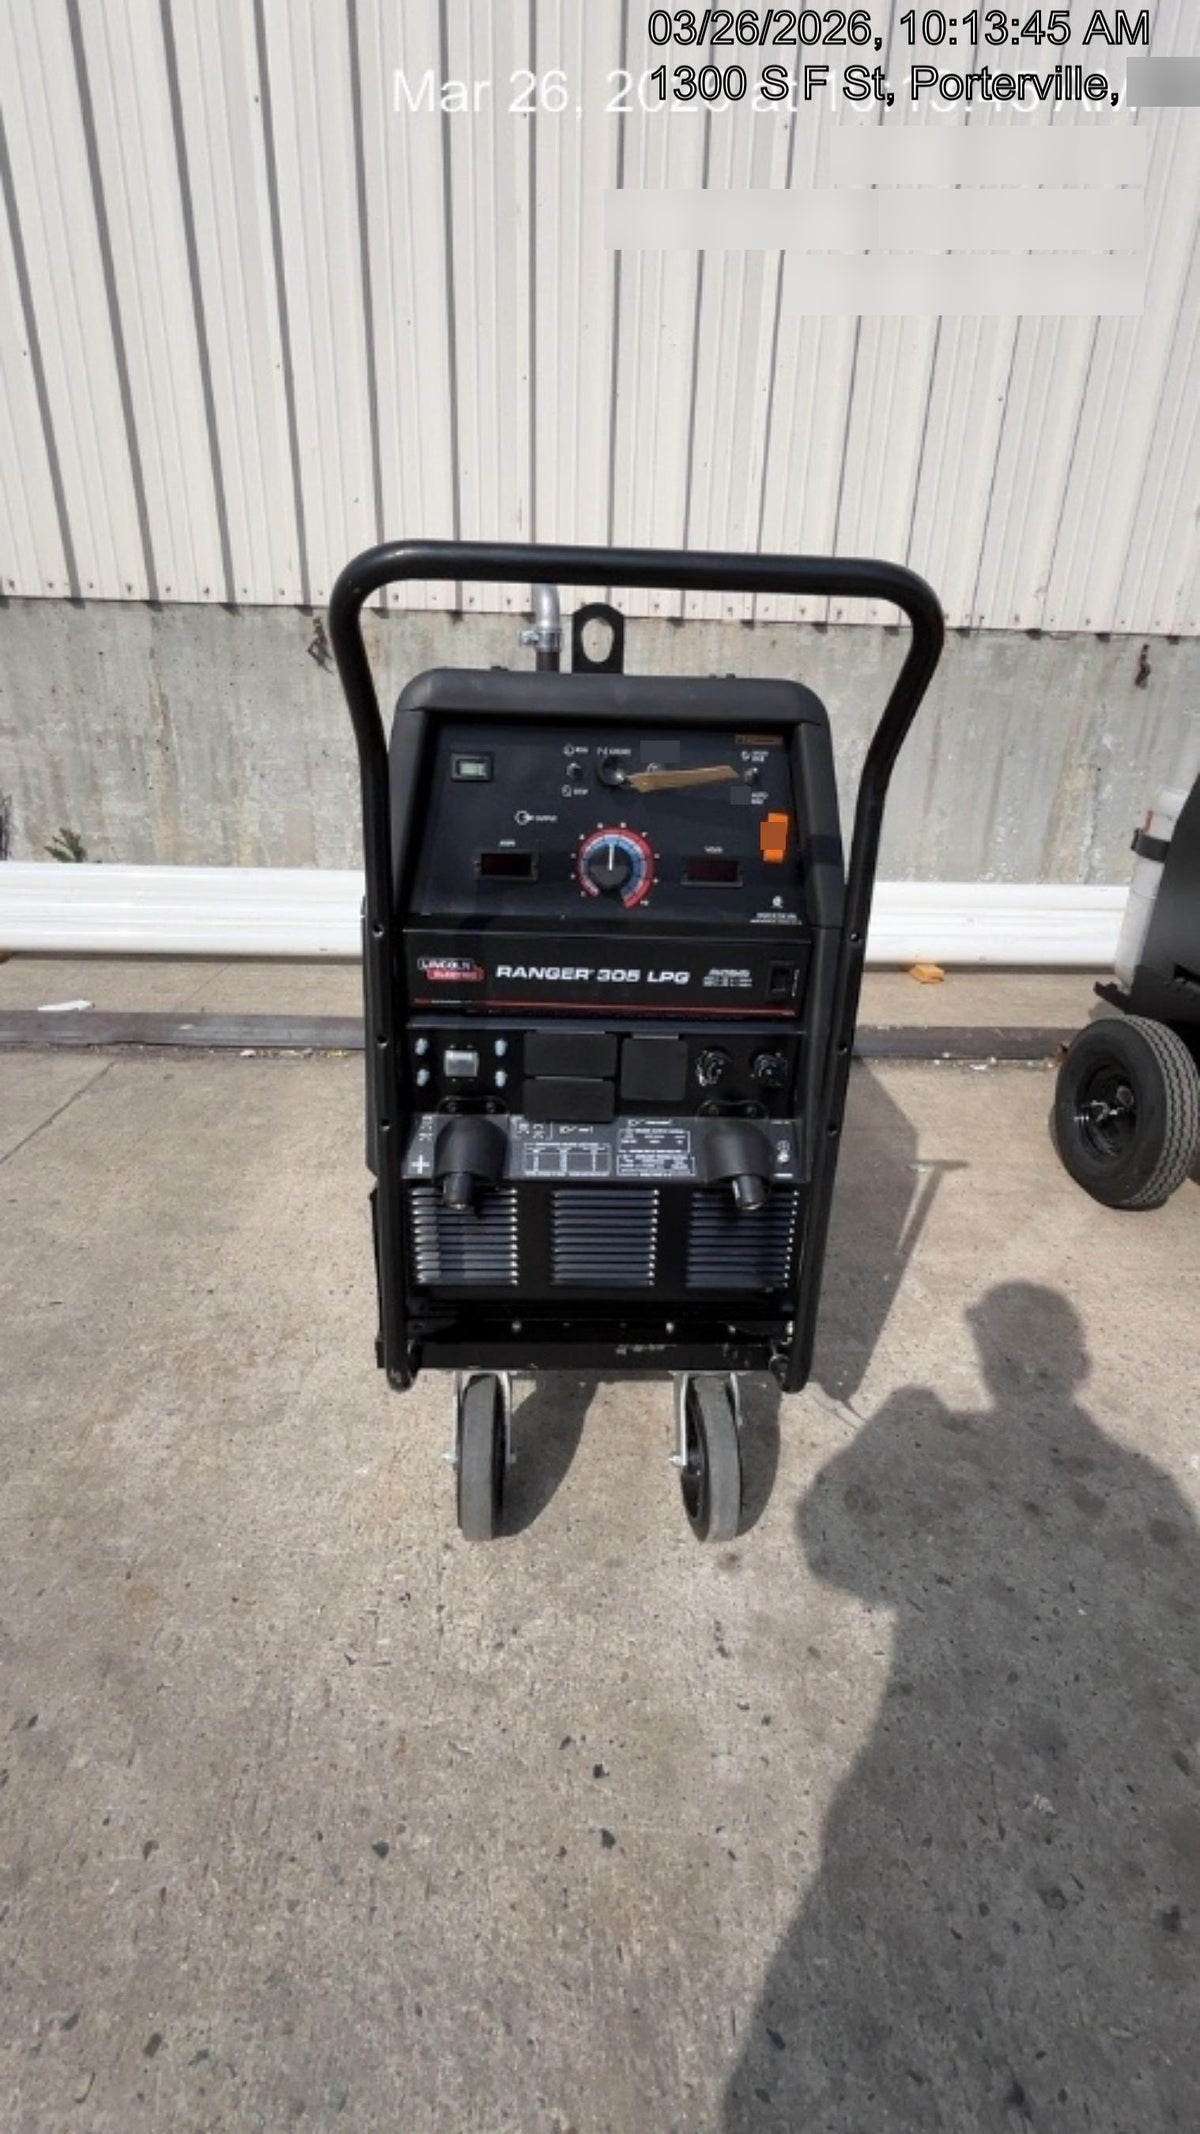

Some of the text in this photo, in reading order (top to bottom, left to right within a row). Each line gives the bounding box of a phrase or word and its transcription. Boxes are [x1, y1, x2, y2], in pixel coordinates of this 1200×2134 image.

[495, 965, 590, 981] RANGER
[597, 968, 642, 982] 305
[647, 970, 691, 985] LPG
